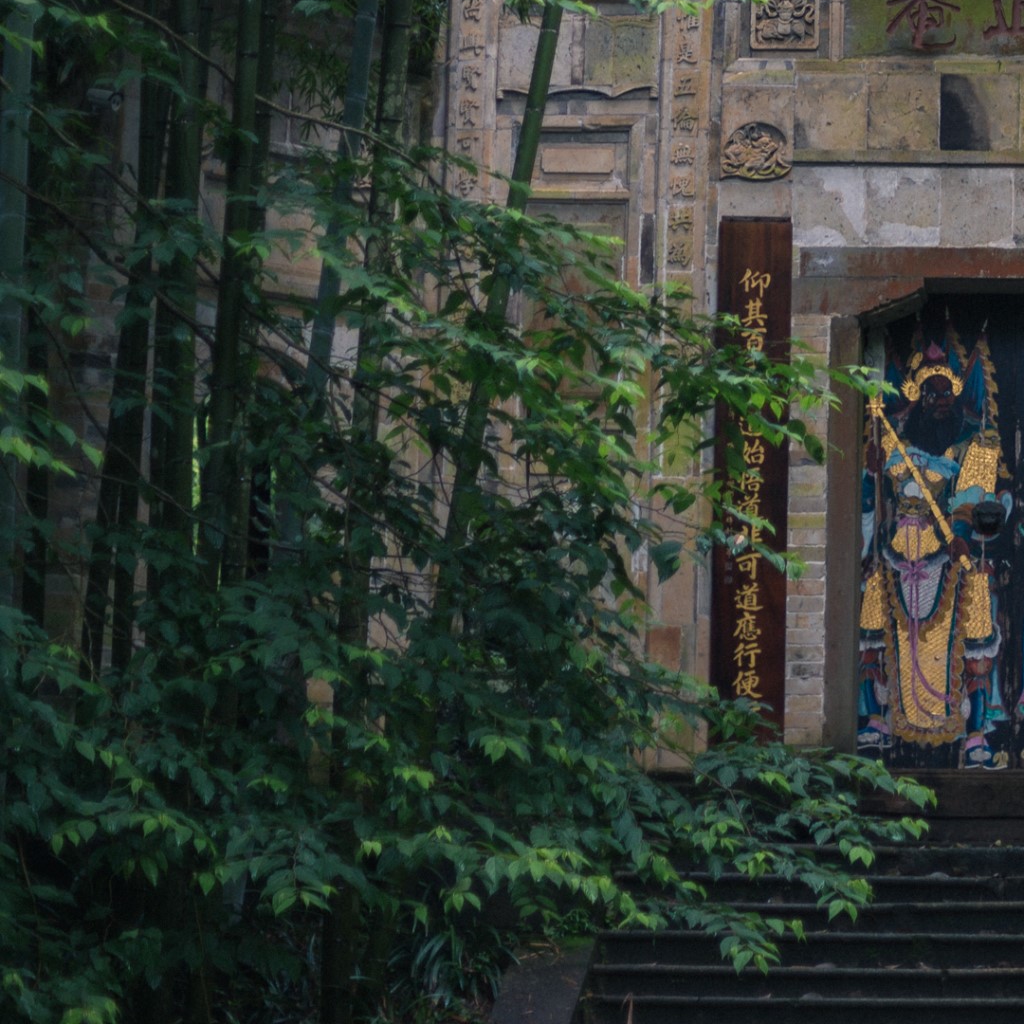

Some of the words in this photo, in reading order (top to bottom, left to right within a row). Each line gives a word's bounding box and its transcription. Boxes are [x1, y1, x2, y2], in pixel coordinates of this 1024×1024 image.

[732, 267, 771, 713] 仰其百始悟道非可道應行便
